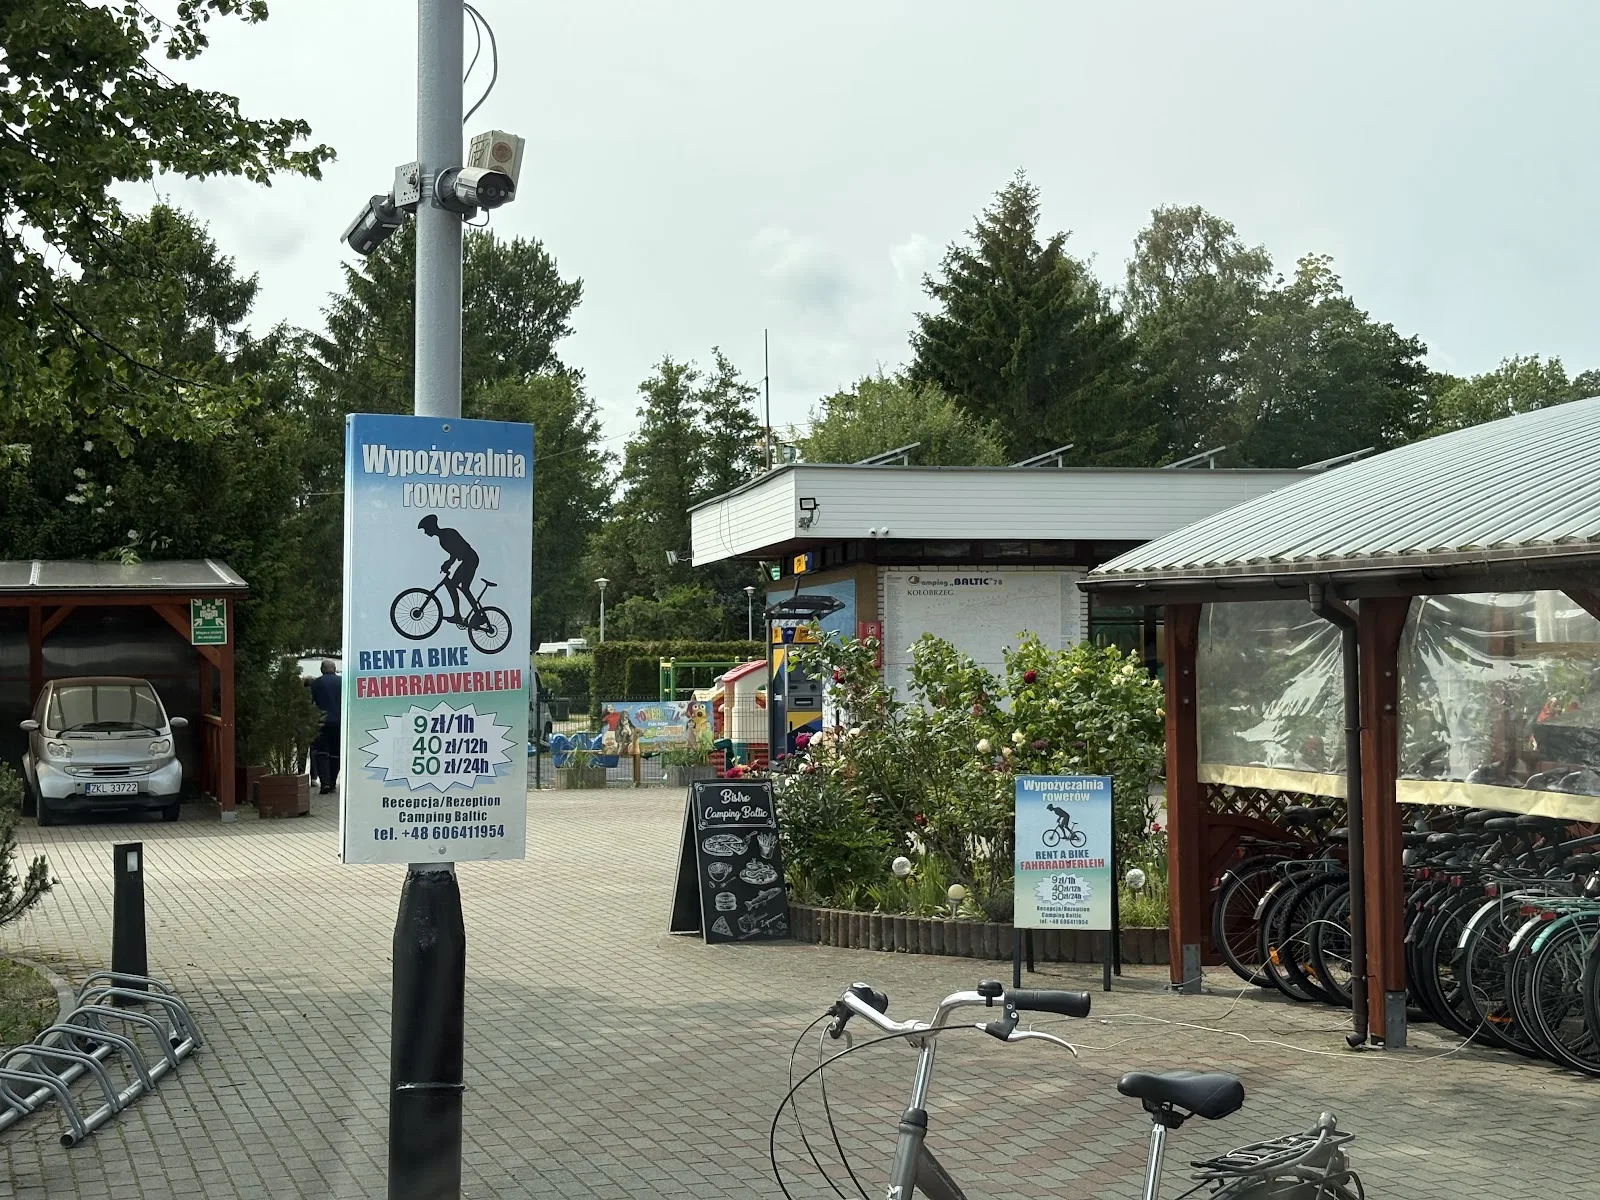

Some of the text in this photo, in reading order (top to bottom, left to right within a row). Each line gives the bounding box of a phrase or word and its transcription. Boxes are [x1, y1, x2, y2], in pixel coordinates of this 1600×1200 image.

[362, 444, 527, 478] Wypożyczalnia
[403, 479, 501, 510] rowerów
[359, 646, 469, 671] RENT A BIKE
[357, 669, 523, 699] FAHRRADVERLEIH
[91, 783, 137, 793] ZKL 33722
[1023, 779, 1104, 791] Wypożyczalnia
[382, 796, 501, 809] Recepcja/Rezeption
[720, 788, 752, 804] Bistro
[1042, 790, 1090, 801] rowerów
[398, 810, 488, 824] Camping Baltic
[704, 805, 769, 821] Camping Baltic
[373, 825, 505, 841] tel. +48 606411954
[1035, 849, 1089, 860] RENT A BIKE
[1020, 858, 1105, 871] FAHRRADVERLEIH
